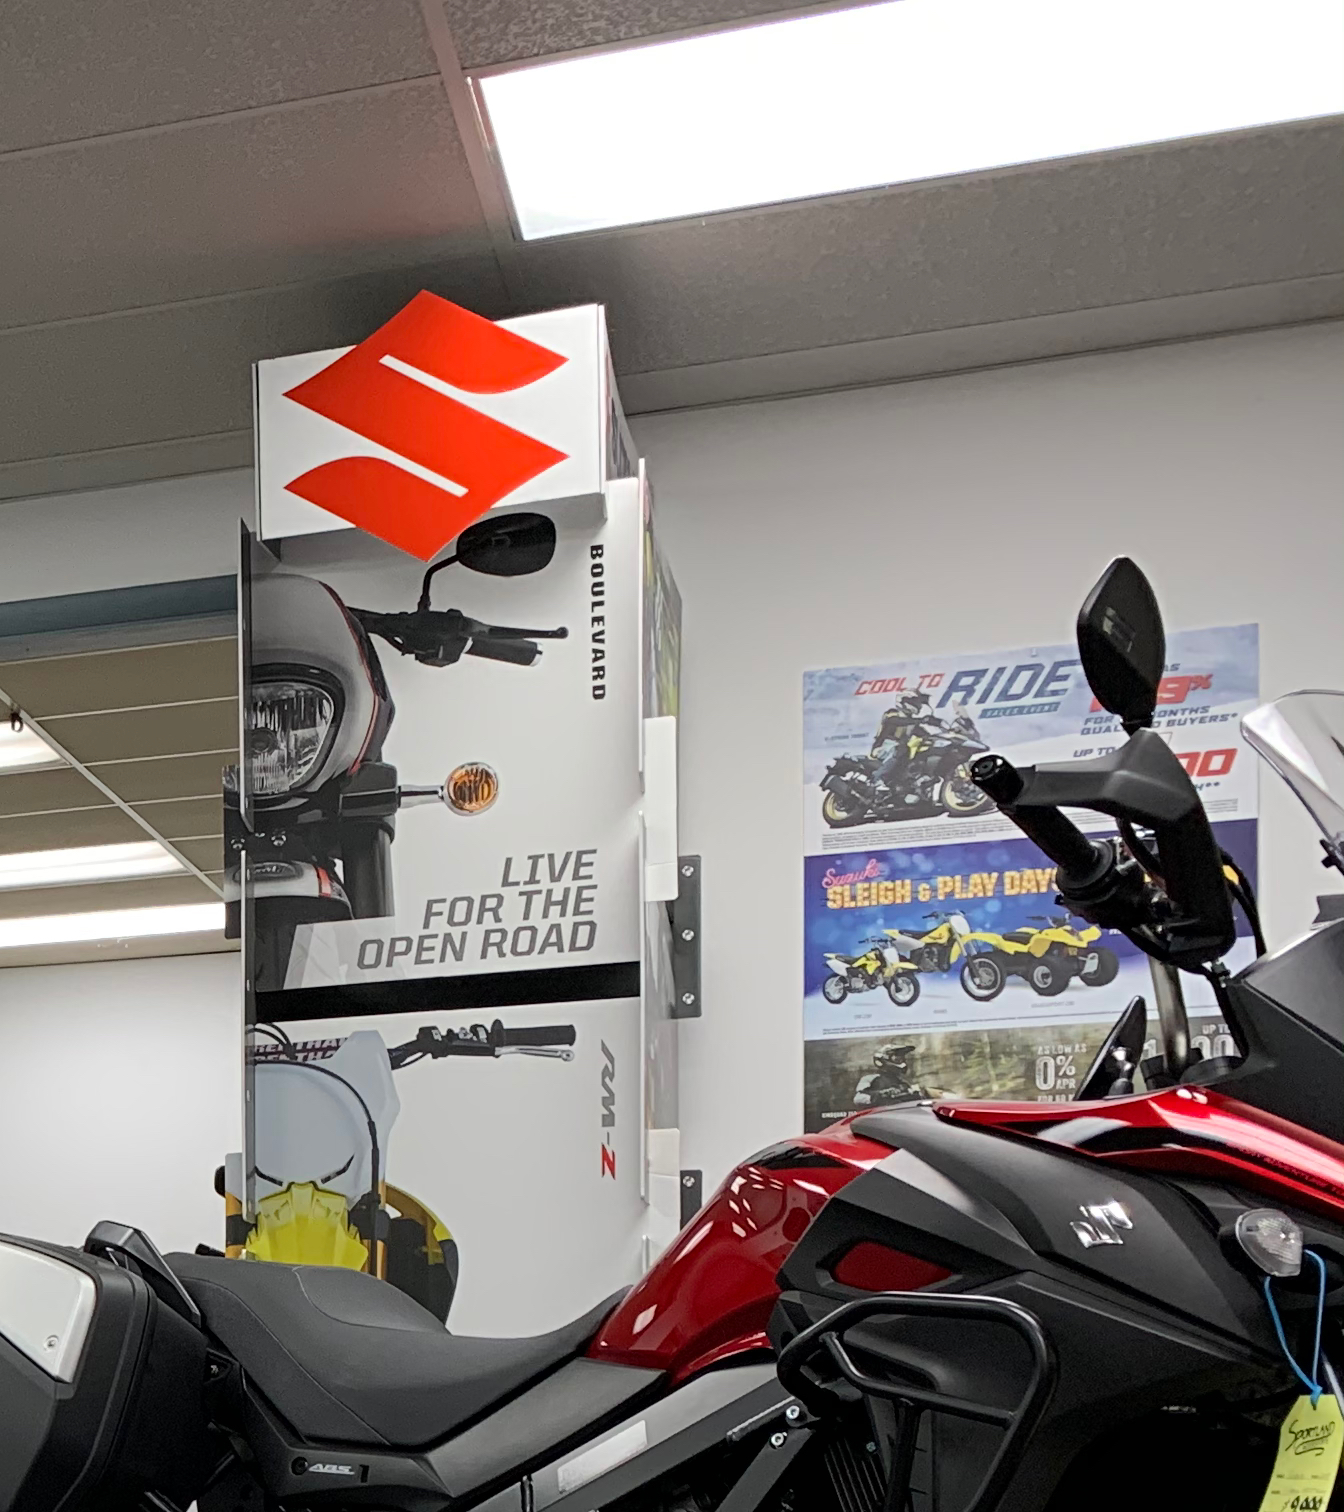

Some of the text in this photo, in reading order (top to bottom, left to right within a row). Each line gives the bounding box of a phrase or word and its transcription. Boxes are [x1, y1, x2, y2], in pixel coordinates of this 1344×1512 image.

[590, 544, 606, 701] BOULEVARD
[854, 659, 1082, 708] COOL TO RIDE
[1084, 706, 1210, 726] FOR ONTHS
[1073, 748, 1093, 758] UP
[501, 848, 598, 889] LIVE
[821, 859, 883, 890] Suzuki
[422, 884, 598, 930] FOR THE
[825, 879, 912, 911] SLEIGH
[917, 882, 931, 902] &
[938, 871, 999, 901] PLAY
[357, 919, 598, 971] OPEN ROAD
[1202, 1024, 1217, 1034] UP
[1055, 1079, 1076, 1090] APR
[308, 1463, 355, 1475] ABS
